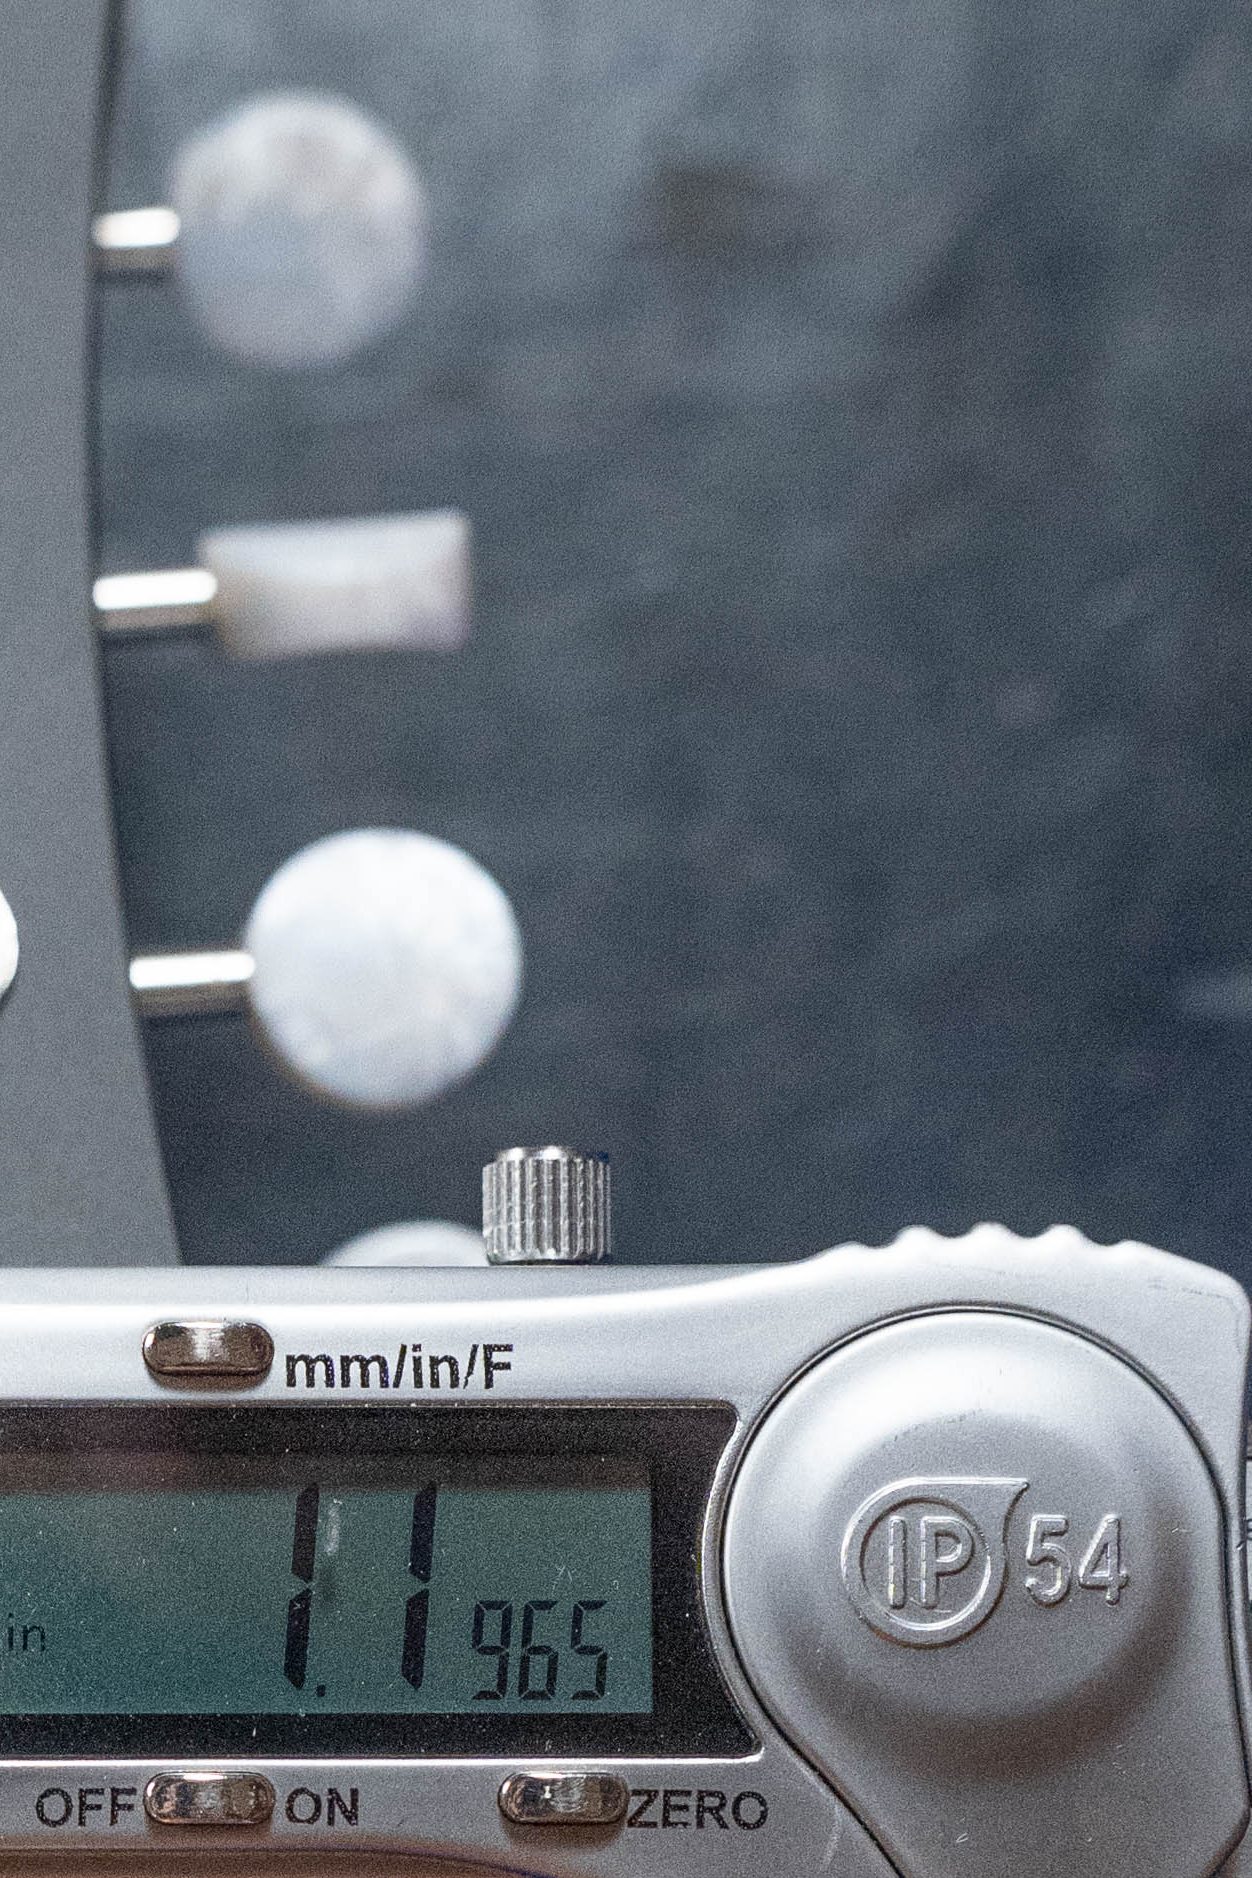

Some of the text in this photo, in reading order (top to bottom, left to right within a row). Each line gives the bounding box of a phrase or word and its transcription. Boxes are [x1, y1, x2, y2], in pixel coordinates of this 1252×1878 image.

[285, 1343, 514, 1390] mm/in/F
[886, 1512, 1129, 1610] IP 54
[7, 1612, 47, 1653] in
[34, 1786, 138, 1828] OFF
[285, 1786, 360, 1828] ON
[627, 1787, 769, 1831] ZERO
